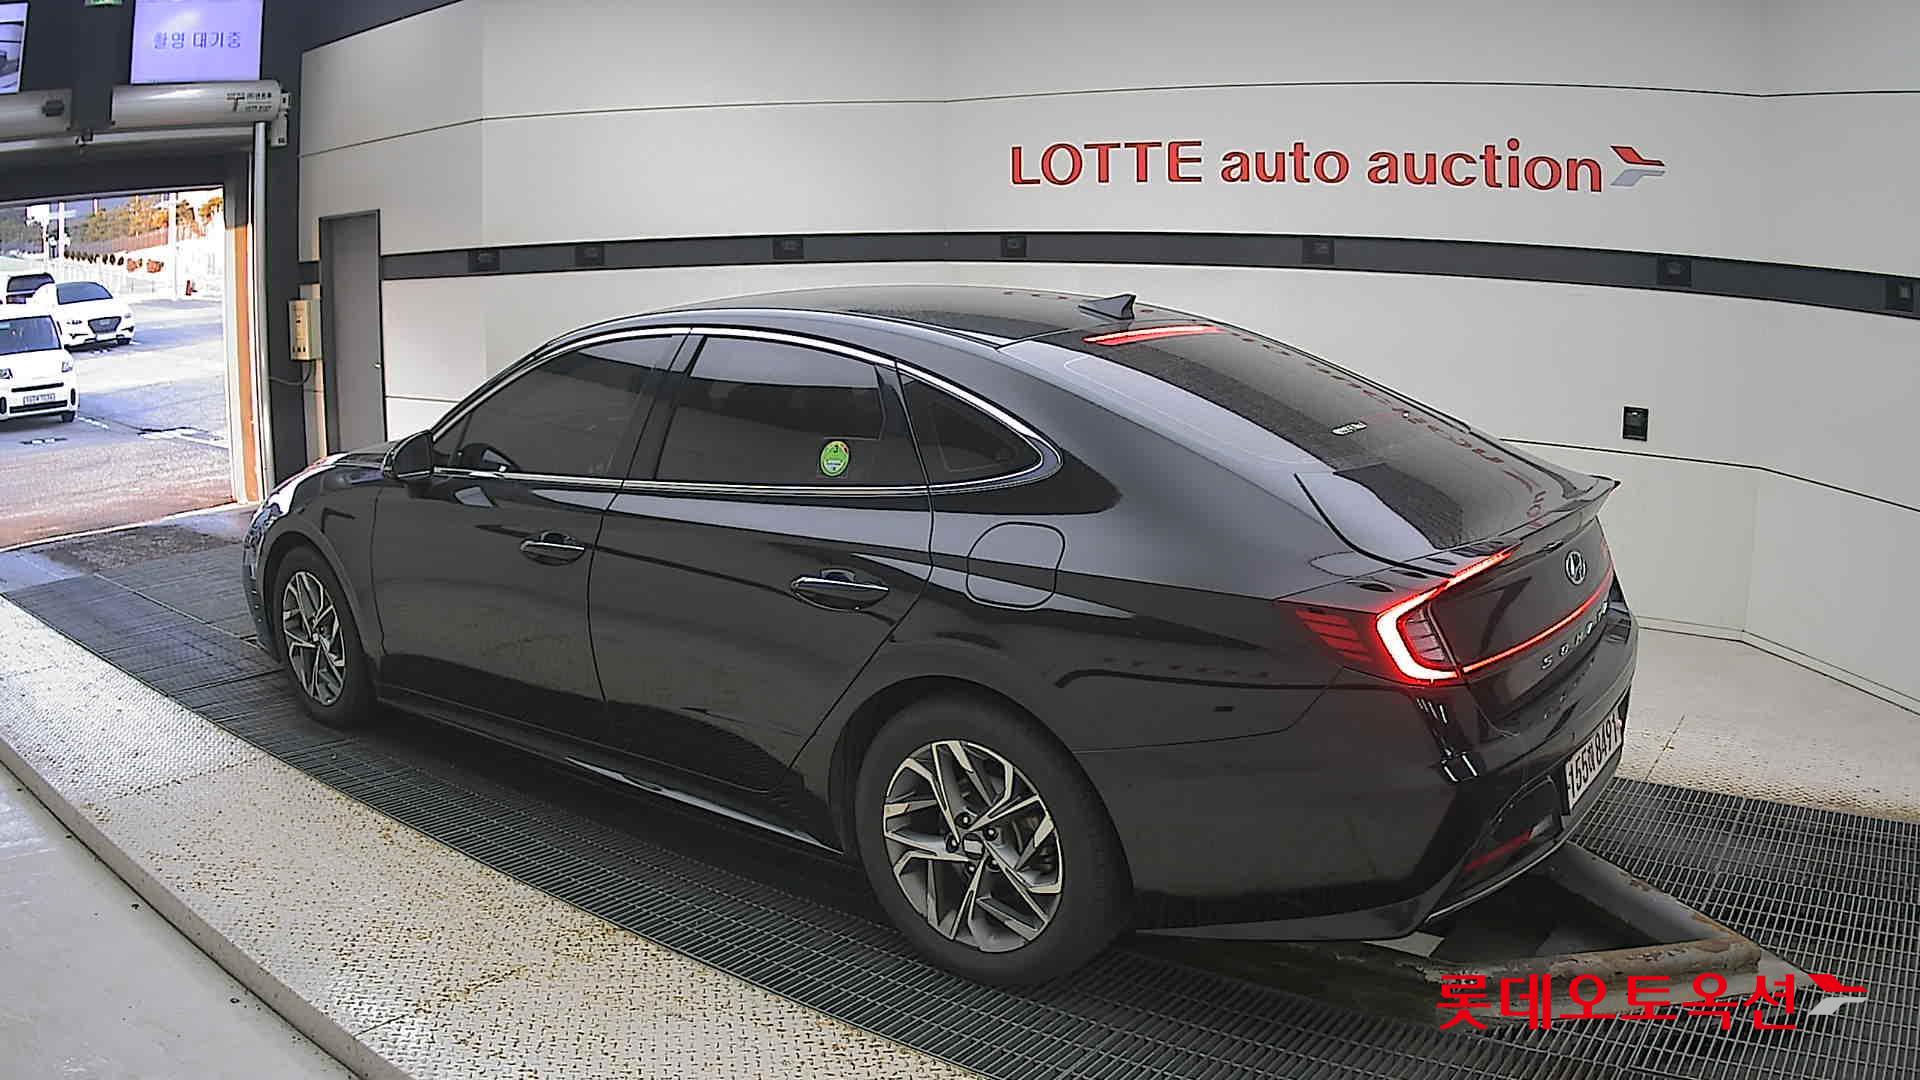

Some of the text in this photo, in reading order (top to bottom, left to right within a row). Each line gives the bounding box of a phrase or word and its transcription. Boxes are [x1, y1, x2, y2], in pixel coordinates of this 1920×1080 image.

[194, 32, 241, 48] 대기중
[1011, 138, 1603, 192] LOTTE auto auction
